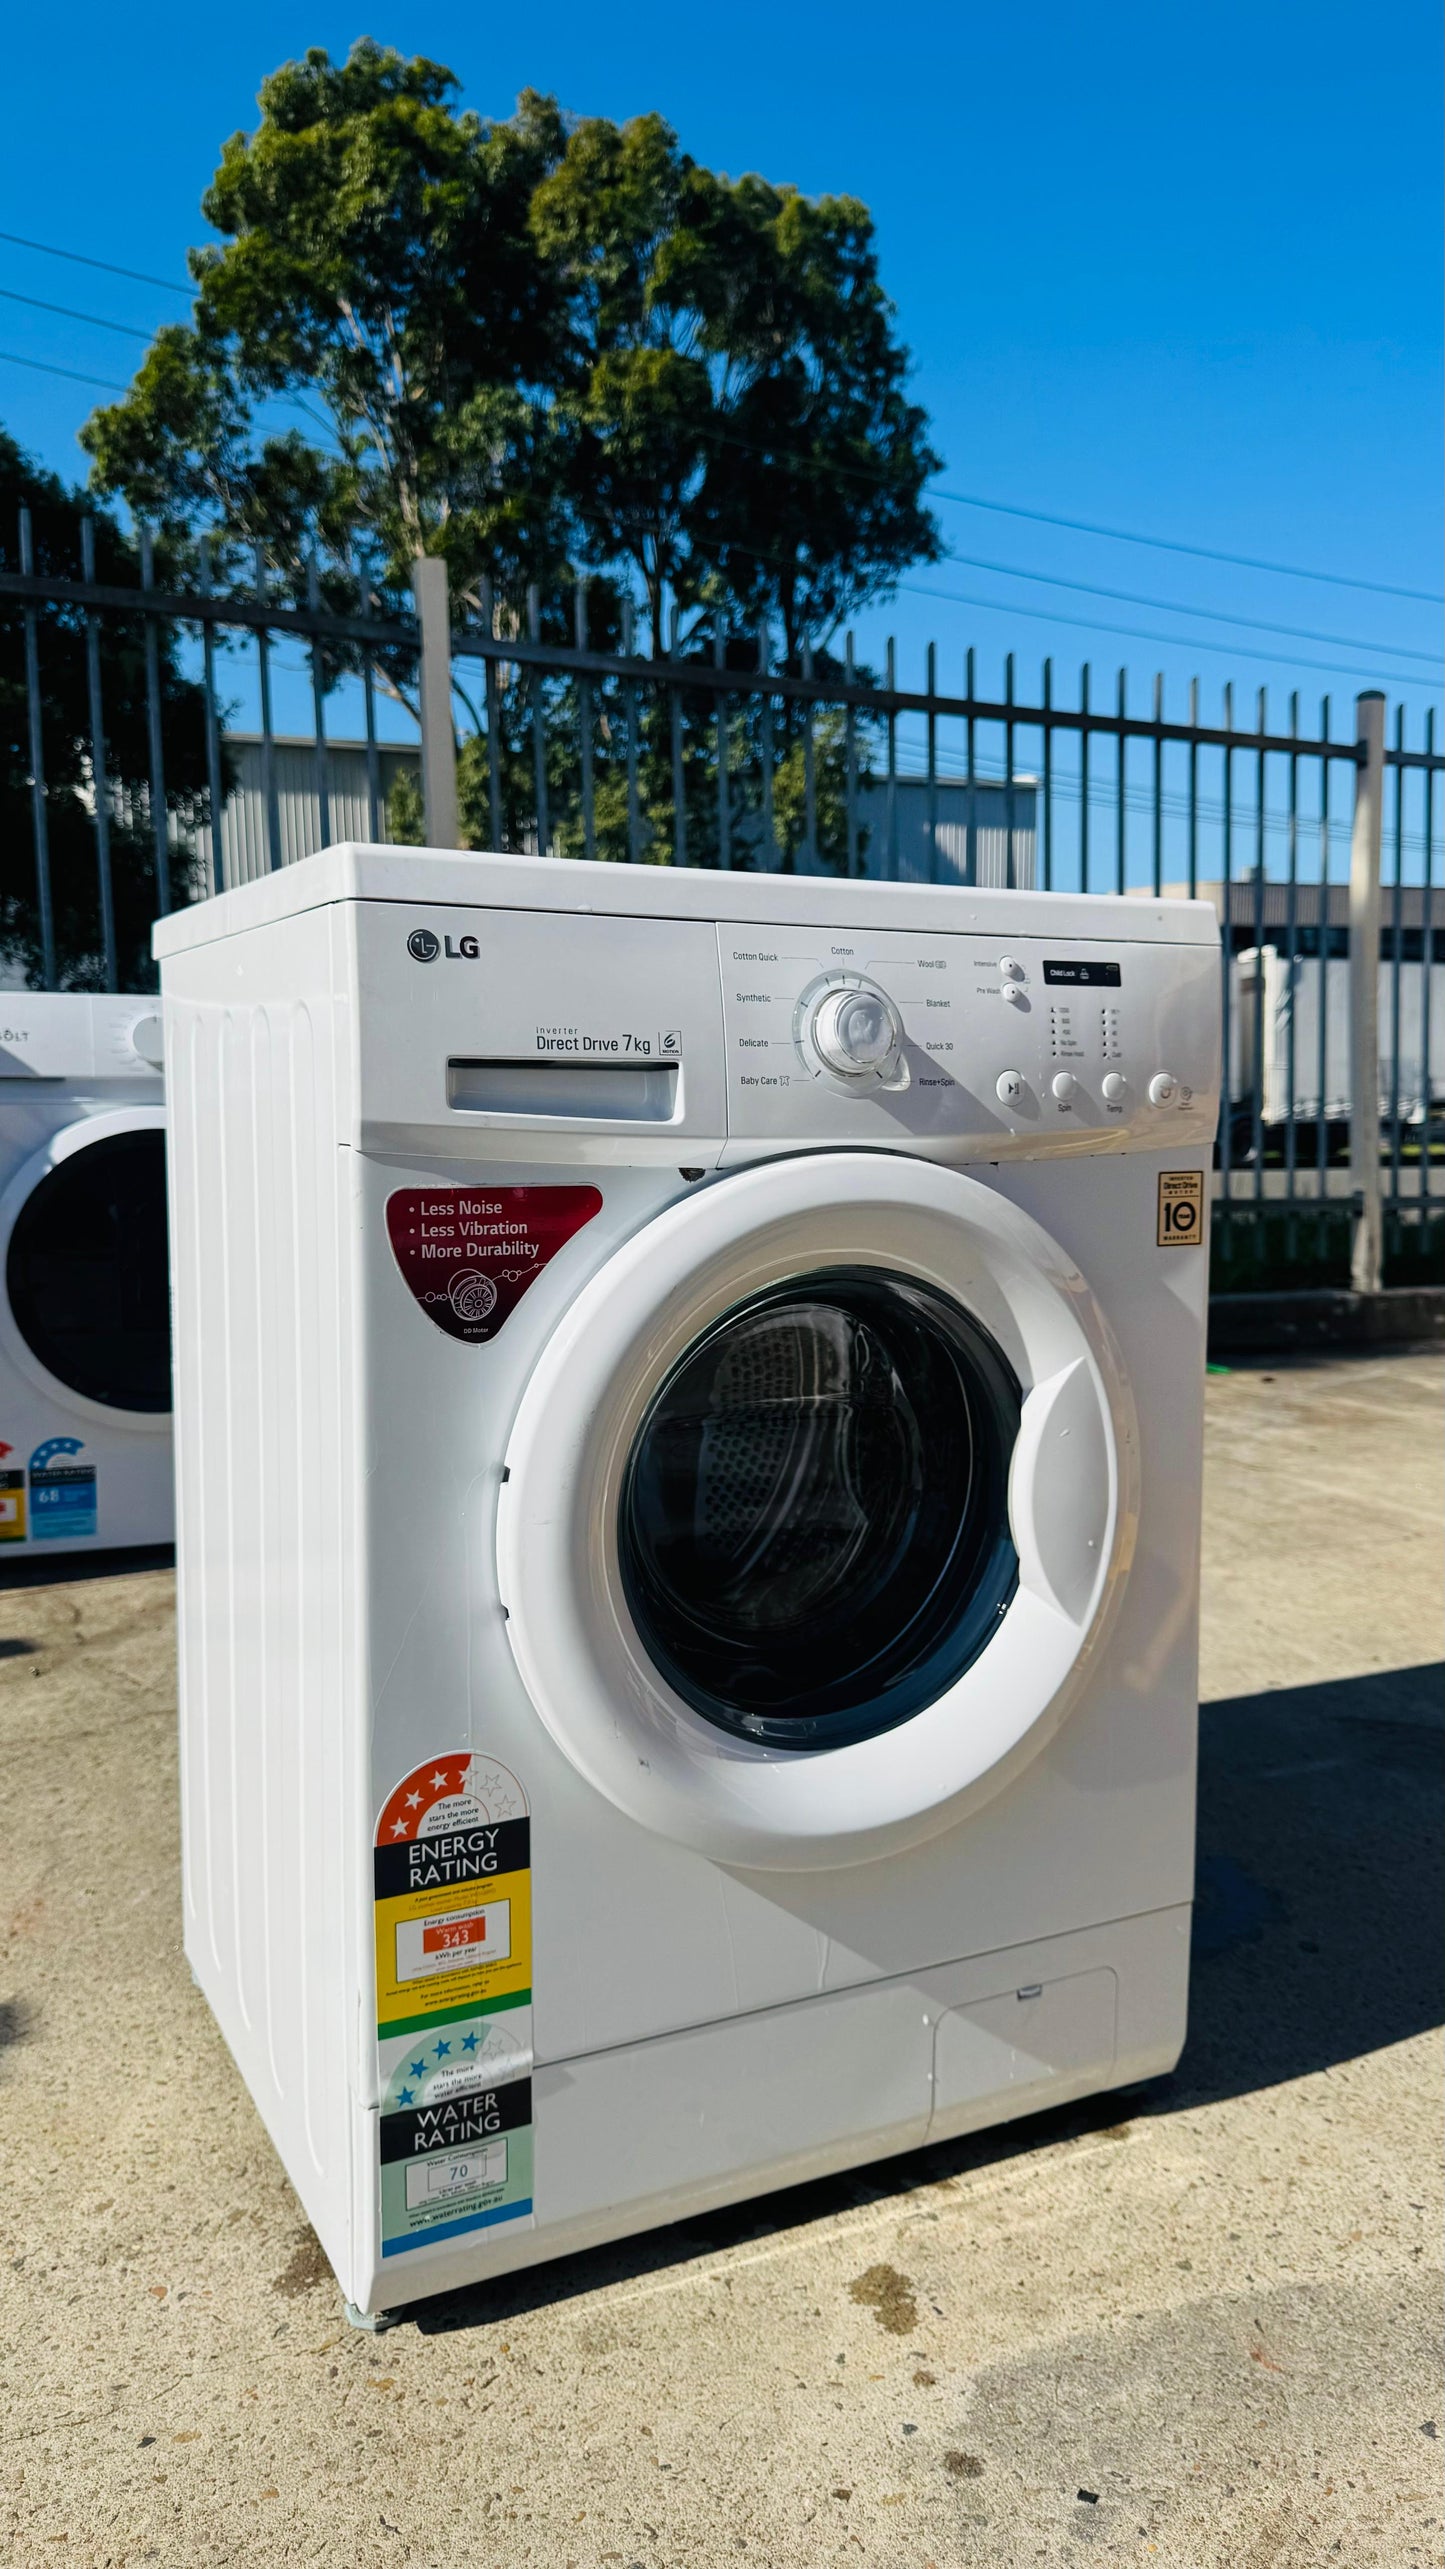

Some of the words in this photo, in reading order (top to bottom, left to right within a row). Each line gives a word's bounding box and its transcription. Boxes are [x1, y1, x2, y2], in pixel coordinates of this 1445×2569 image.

[444, 936, 480, 959] LG
[831, 947, 854, 956] Cotton
[734, 952, 757, 961] Cotton
[758, 953, 778, 962] Quick
[918, 960, 934, 968] Wool
[737, 994, 771, 1004] Synthetic
[926, 1000, 951, 1008] Blanket
[536, 1026, 578, 1034] Inverter
[536, 1035, 578, 1051] Direct
[583, 1036, 618, 1051] Drive
[739, 1039, 768, 1047] Delicate
[926, 1042, 944, 1051] Quick
[741, 1076, 759, 1086] Baby
[760, 1077, 778, 1085] Care
[919, 1078, 955, 1087] Rinse+Spin
[1058, 1104, 1071, 1112] Spin
[1107, 1105, 1122, 1113] Temp
[421, 1201, 454, 1216] Less
[459, 1200, 502, 1215] Noise
[1164, 1202, 1196, 1232] 10
[421, 1223, 454, 1237] Less
[459, 1221, 528, 1236] Vibration
[422, 1244, 462, 1258] More
[466, 1240, 539, 1258] Durability
[39, 1488, 60, 1503] 68
[438, 1802, 450, 1810] The
[429, 1814, 445, 1822] stars
[461, 1808, 479, 1816] more
[427, 1823, 450, 1832] energy
[452, 1817, 478, 1827] efficient
[409, 1828, 500, 1865] ENERGY
[410, 1852, 498, 1888] RATING
[424, 1918, 445, 1926] Energy
[447, 1908, 485, 1921] consumption
[443, 1930, 469, 1948] 343
[452, 1950, 462, 1958] per
[464, 1947, 476, 1955] year
[457, 2065, 473, 2074] more
[465, 2074, 481, 2082] more
[435, 2090, 452, 2098] water
[417, 2093, 498, 2128] WATER
[415, 2112, 500, 2150] RATING
[427, 2159, 445, 2167] Water
[450, 2165, 468, 2180] 70
